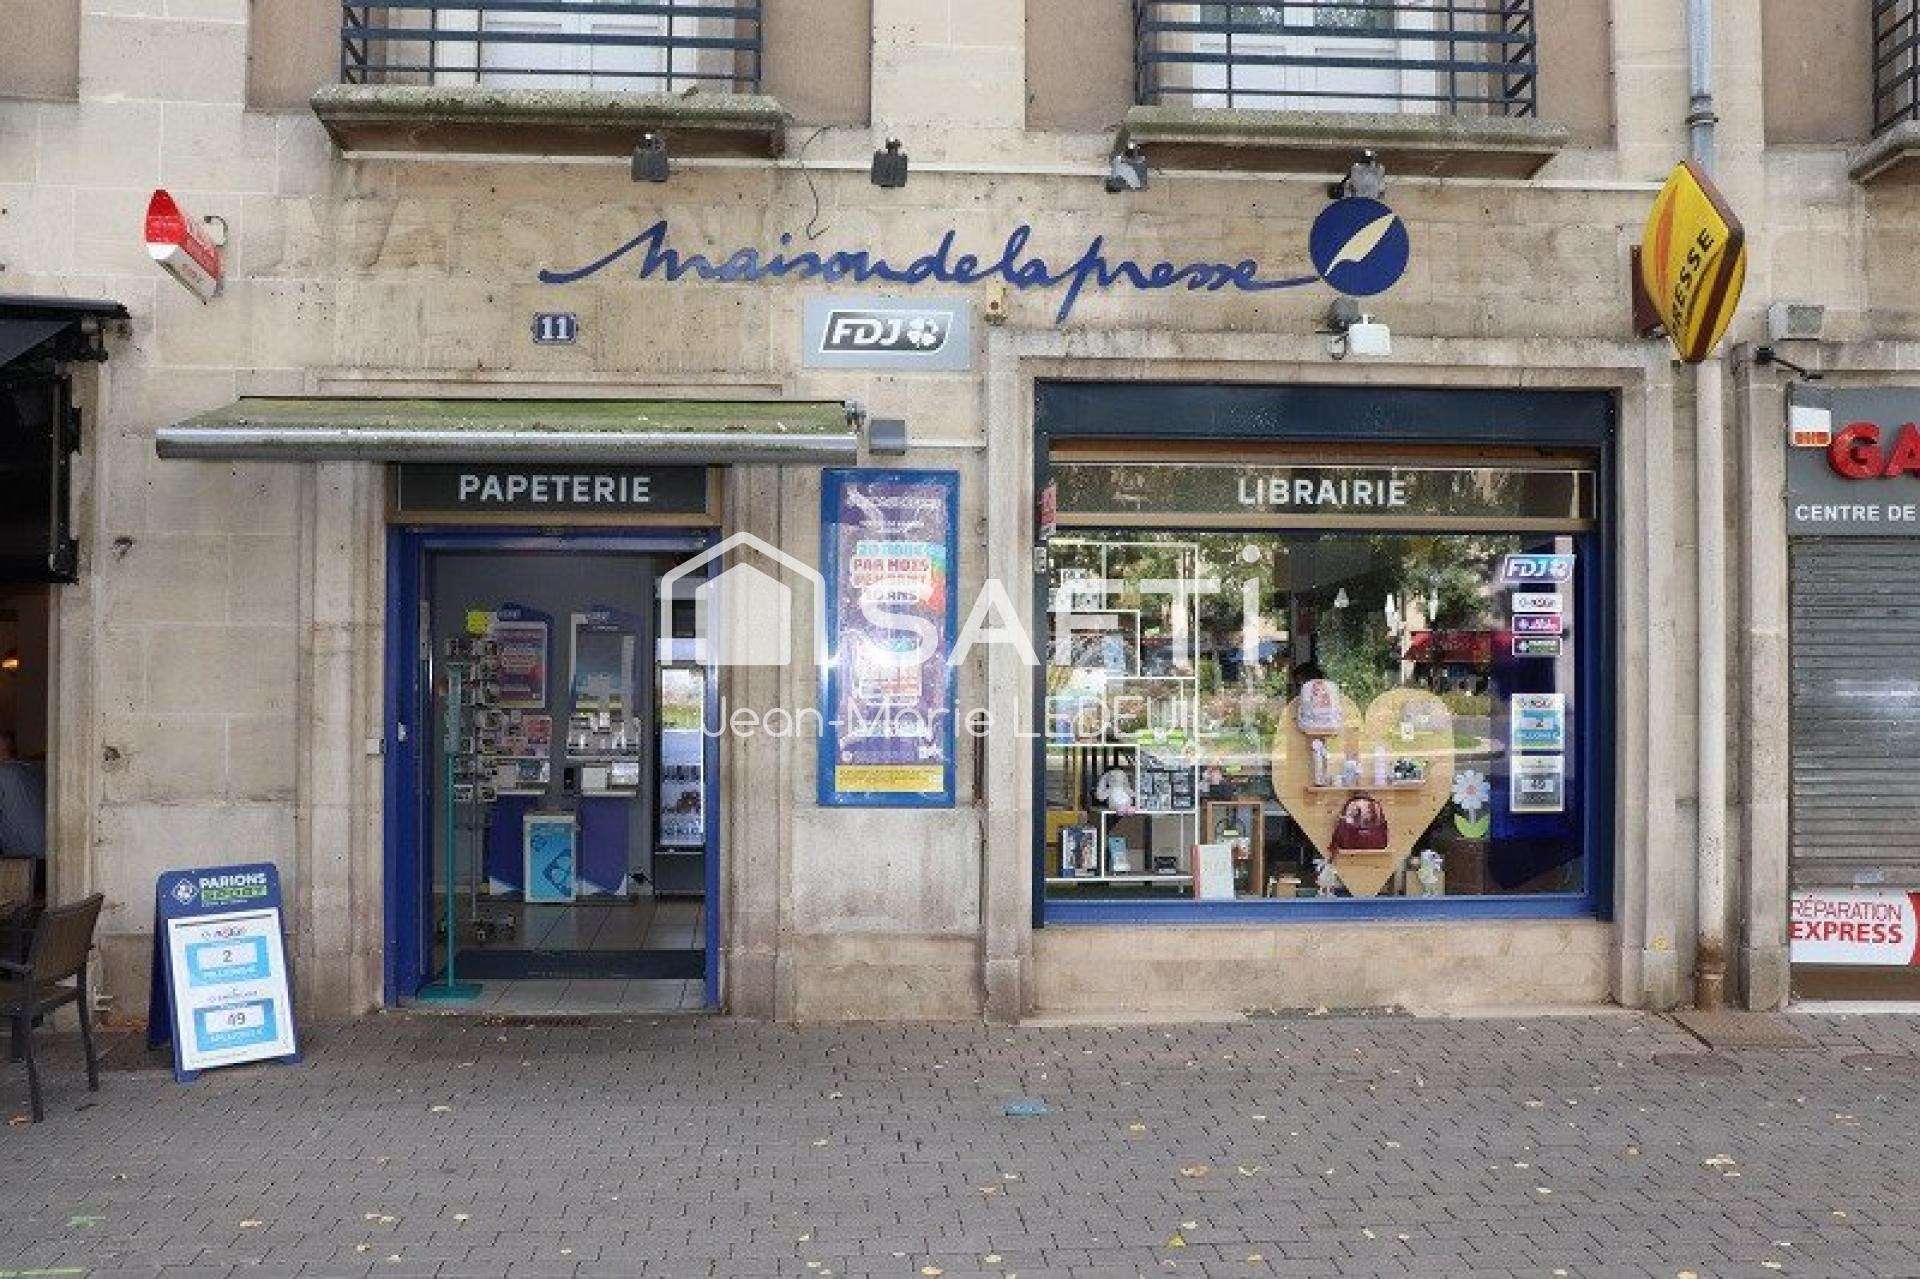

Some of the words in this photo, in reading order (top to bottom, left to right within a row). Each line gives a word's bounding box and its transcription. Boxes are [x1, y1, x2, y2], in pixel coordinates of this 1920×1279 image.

[541, 316, 569, 341] 11
[831, 318, 901, 346] FDJ
[458, 473, 651, 503] PAPETERIE
[1237, 478, 1408, 506] LIBRAIRIE
[1794, 503, 1880, 522] CENTRE
[1888, 503, 1916, 522] DE
[1506, 558, 1549, 577] FDJ
[1788, 920, 1903, 944] EXPRESS
[221, 948, 233, 964] 2
